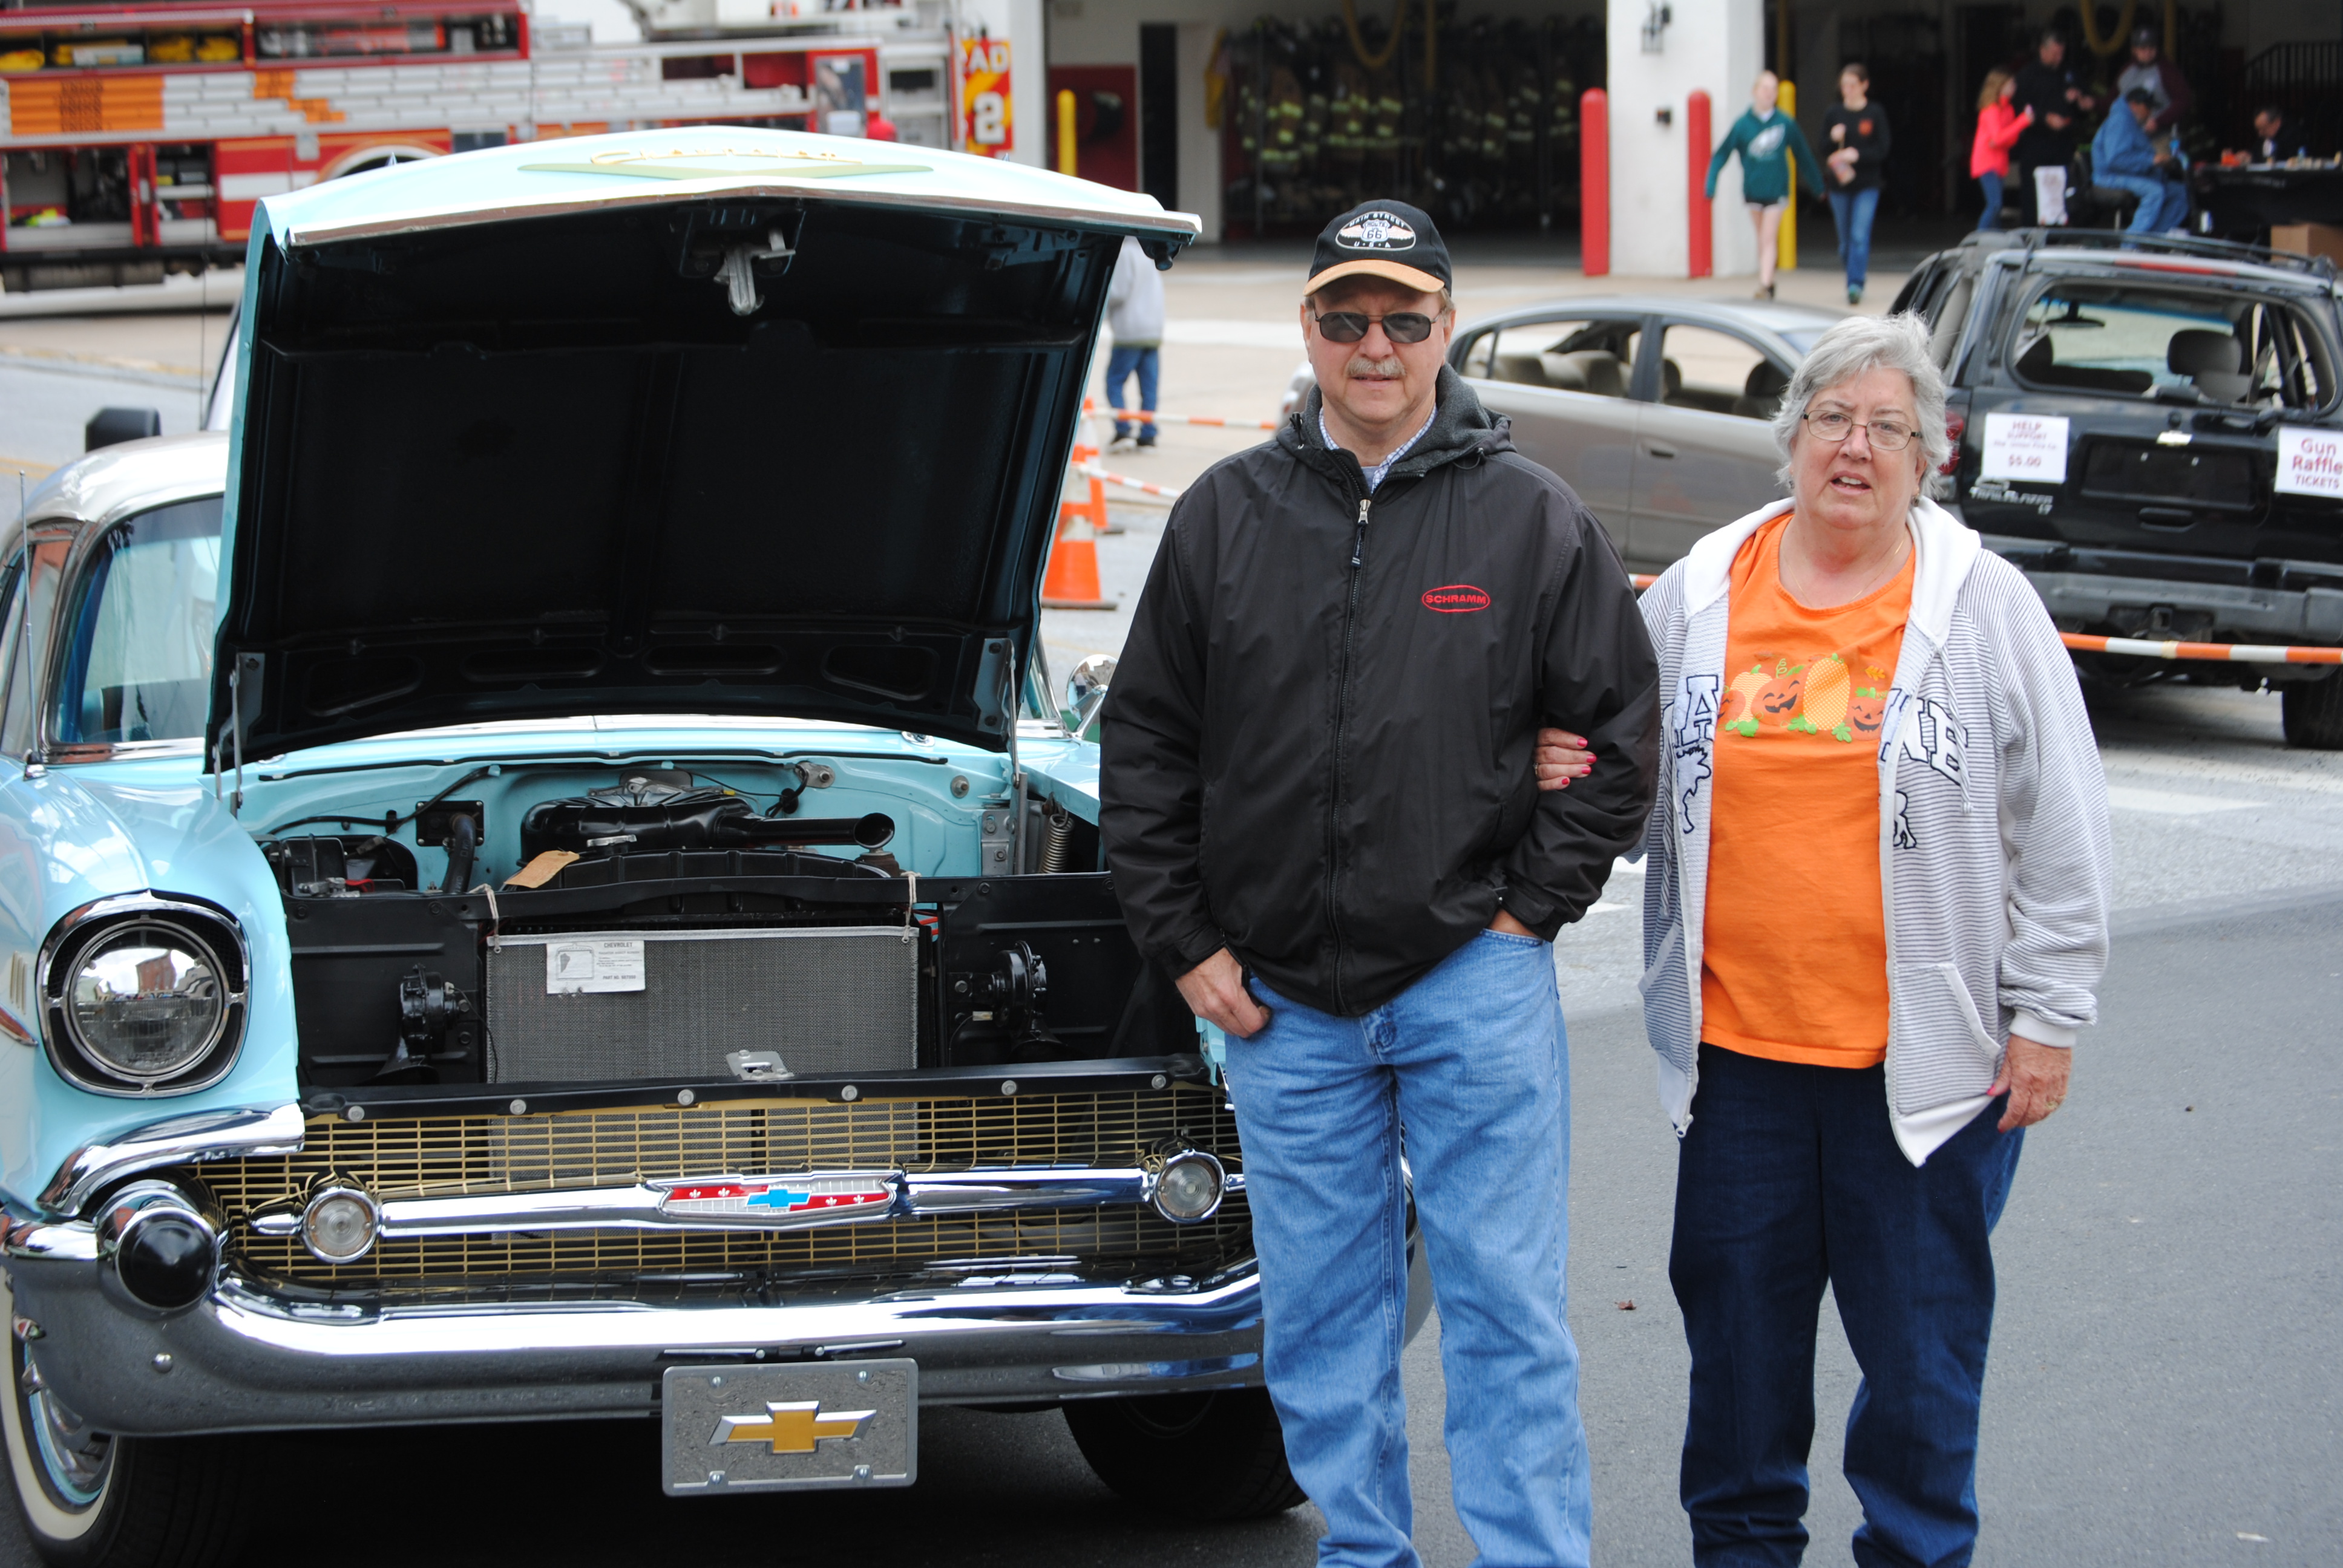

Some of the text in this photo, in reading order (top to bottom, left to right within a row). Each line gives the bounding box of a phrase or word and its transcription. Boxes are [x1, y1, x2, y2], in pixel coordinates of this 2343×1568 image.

[973, 91, 1006, 144] 2
[1349, 212, 1405, 228] MAIN STREET
[1367, 230, 1382, 239] 66
[2301, 437, 2337, 456] Gun
[2008, 454, 2042, 467] $5.00
[2292, 455, 2342, 474] Raffle
[2295, 475, 2340, 489] TICKETS
[1425, 594, 1487, 604] SCHRAMM
